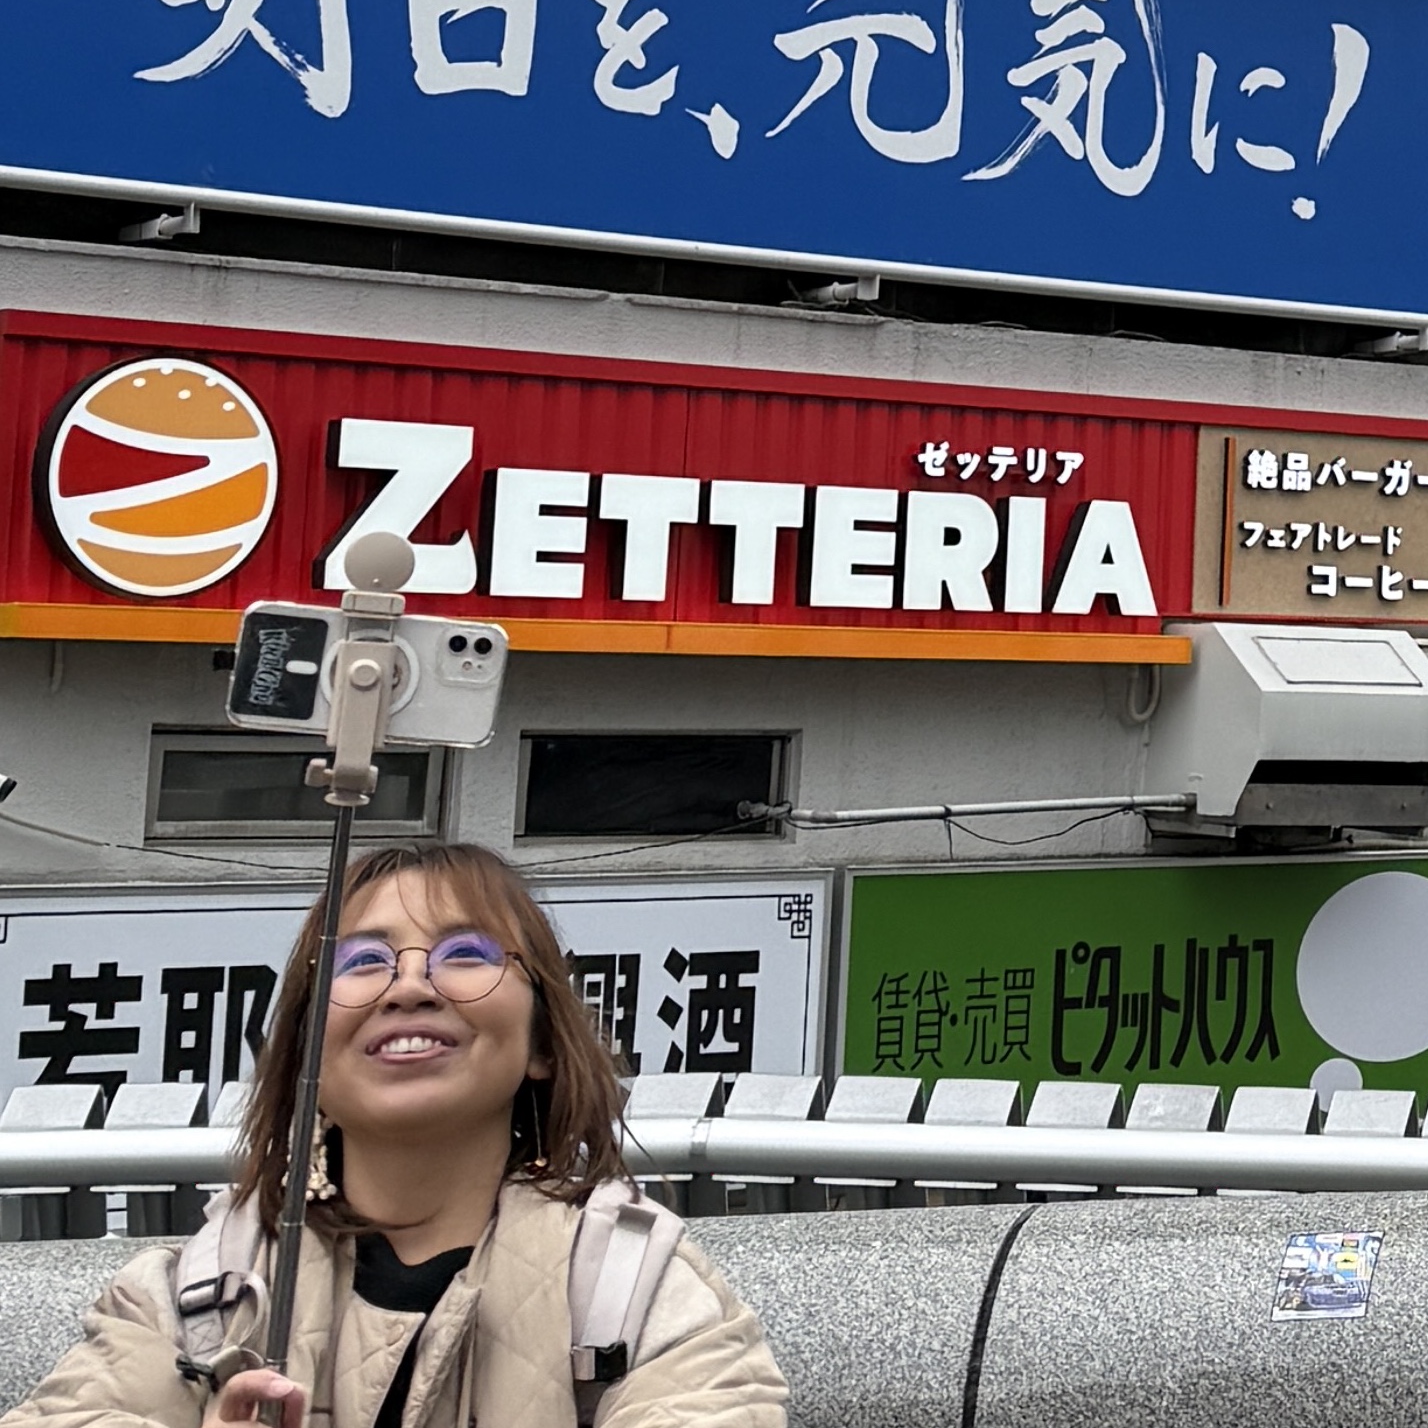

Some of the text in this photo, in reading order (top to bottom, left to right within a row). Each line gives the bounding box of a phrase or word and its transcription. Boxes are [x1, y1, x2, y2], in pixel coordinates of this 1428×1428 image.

[916, 438, 1084, 486] ゼッテリア
[326, 417, 1160, 617] ZETTERIA
[1242, 520, 1402, 556] フェアトレード
[871, 966, 1037, 1074] 賃貸・売買
[1051, 932, 1281, 1078] ピタットハウス
